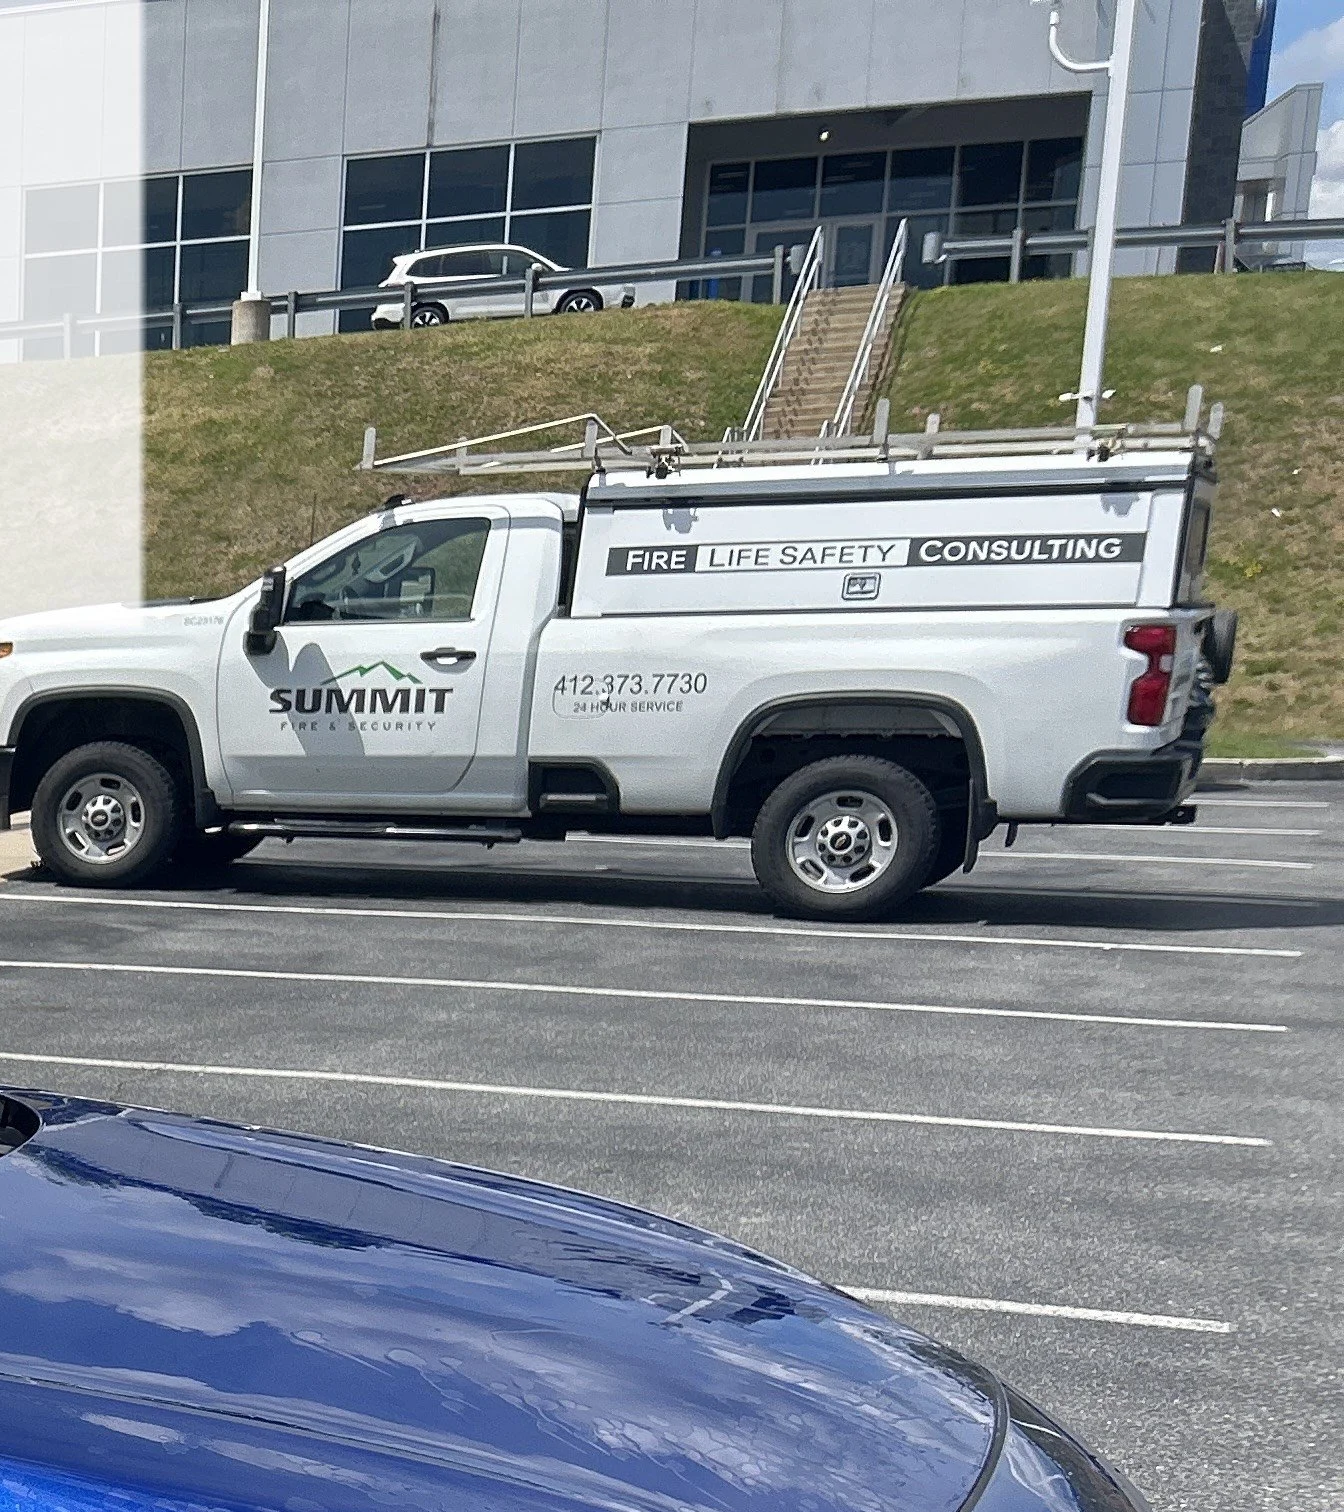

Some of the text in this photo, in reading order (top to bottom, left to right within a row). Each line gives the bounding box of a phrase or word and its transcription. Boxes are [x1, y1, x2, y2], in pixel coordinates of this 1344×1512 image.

[626, 538, 1123, 571] FIRE LIFE SAFETY CONSULTING
[553, 672, 708, 696] 412.373.7730
[268, 687, 454, 715] SUMMIT
[630, 699, 684, 713] SERVICE
[279, 721, 319, 732] FIRE
[348, 721, 437, 732] SECURITY
